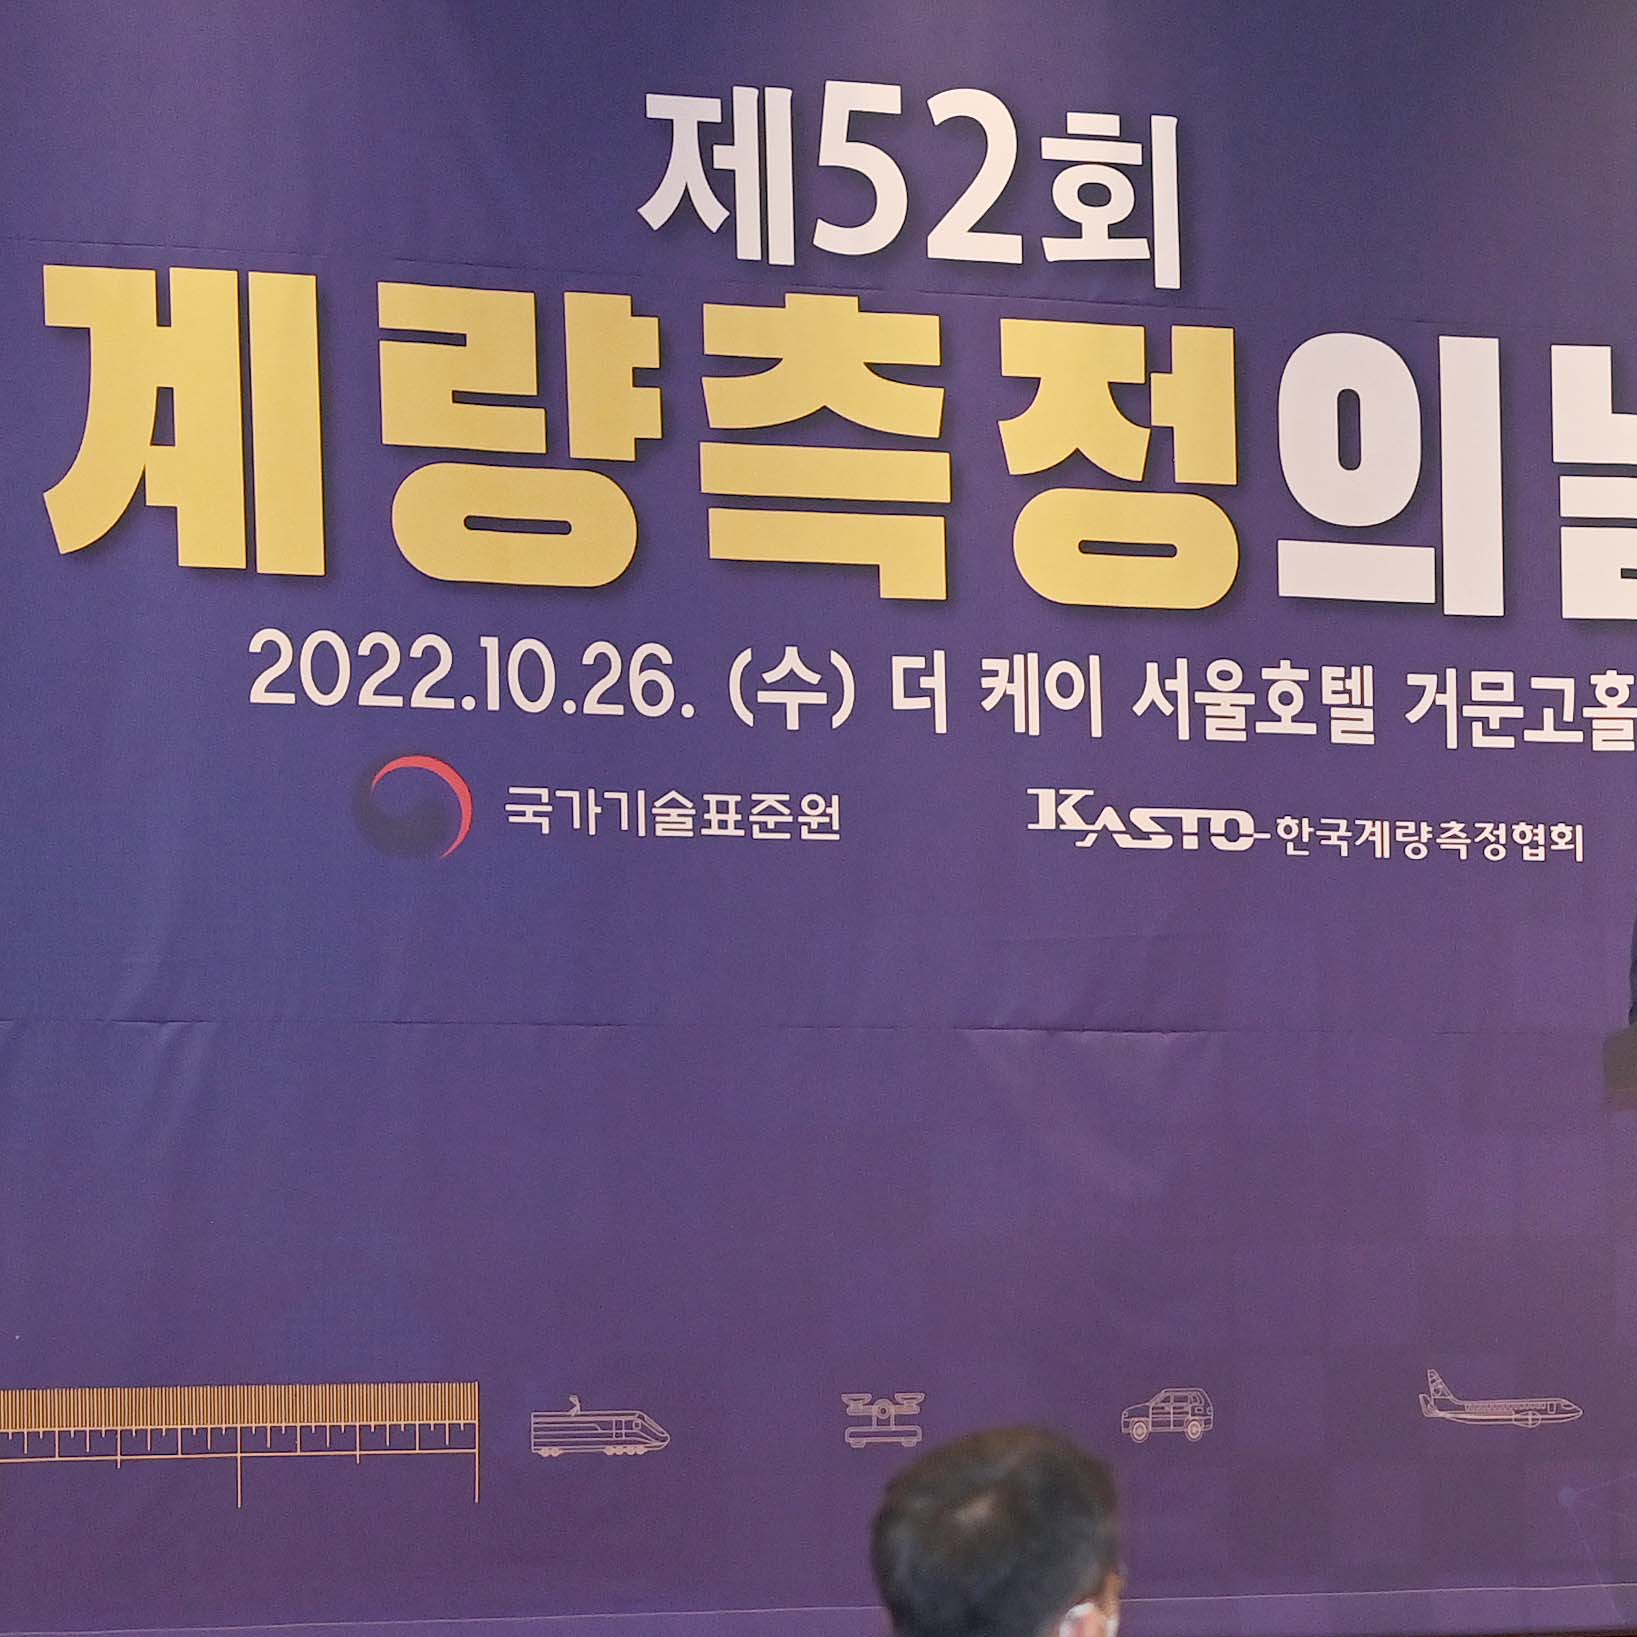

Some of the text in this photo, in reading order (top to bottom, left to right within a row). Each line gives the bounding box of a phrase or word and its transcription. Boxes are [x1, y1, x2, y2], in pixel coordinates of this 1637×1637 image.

[638, 79, 1184, 290] 제52회
[247, 627, 697, 719] 2022.10.26.
[728, 645, 856, 732] (수)
[890, 648, 948, 735] 더
[979, 651, 1103, 739] 케이
[1131, 657, 1376, 746] 서울호텔
[504, 786, 842, 843] 국가기술표준원
